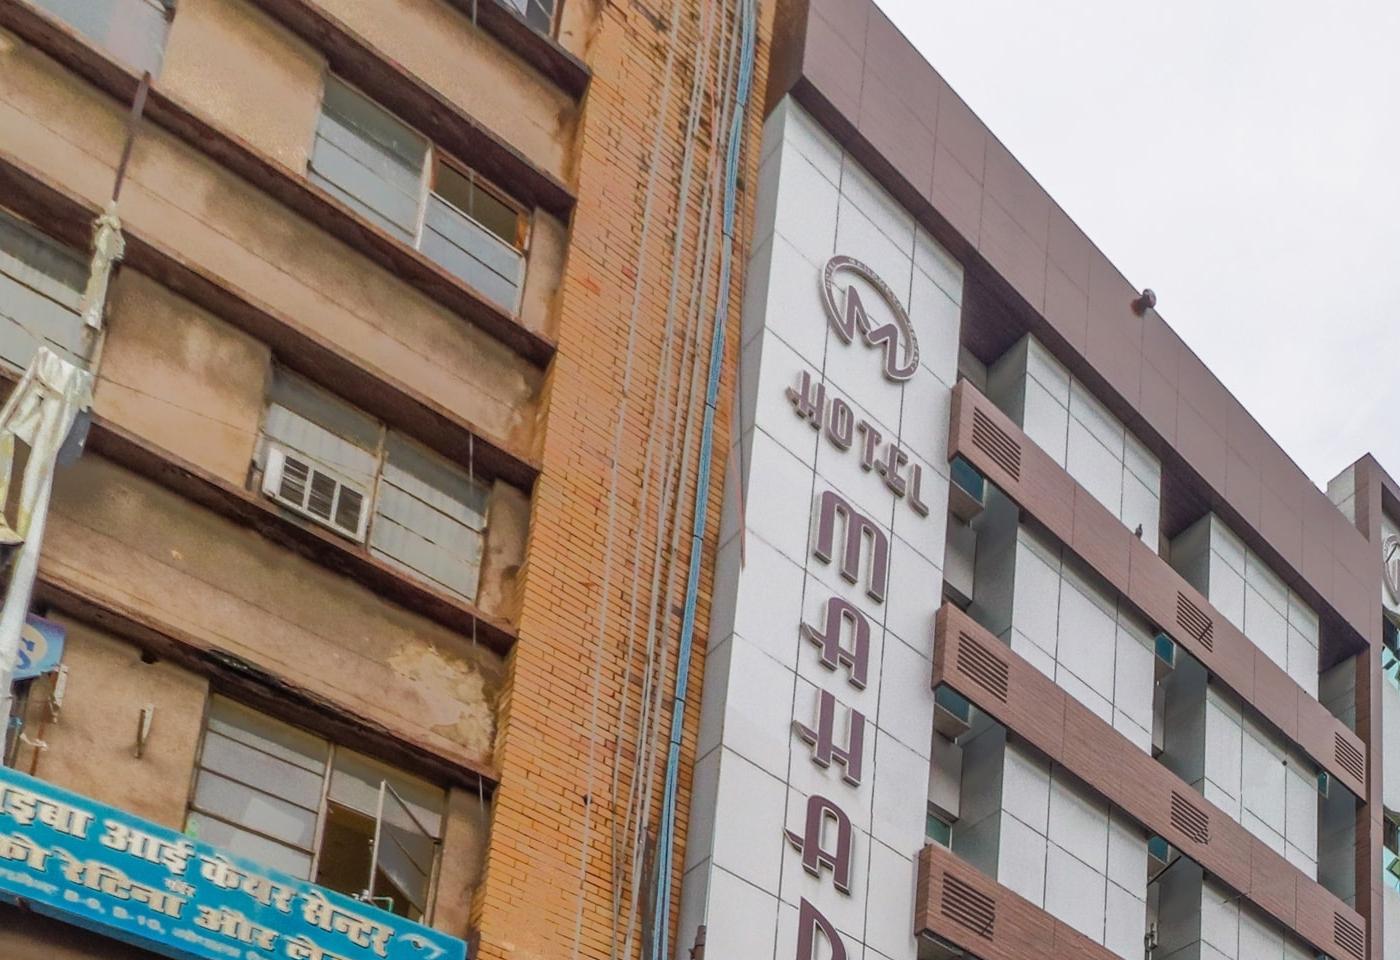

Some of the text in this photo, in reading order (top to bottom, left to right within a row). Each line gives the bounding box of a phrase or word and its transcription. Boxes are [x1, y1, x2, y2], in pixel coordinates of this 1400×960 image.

[786, 369, 929, 517] HOTEL
[0, 831, 52, 872] को
[194, 904, 280, 951] और
[100, 819, 196, 875] आई
[200, 853, 298, 913] केयर
